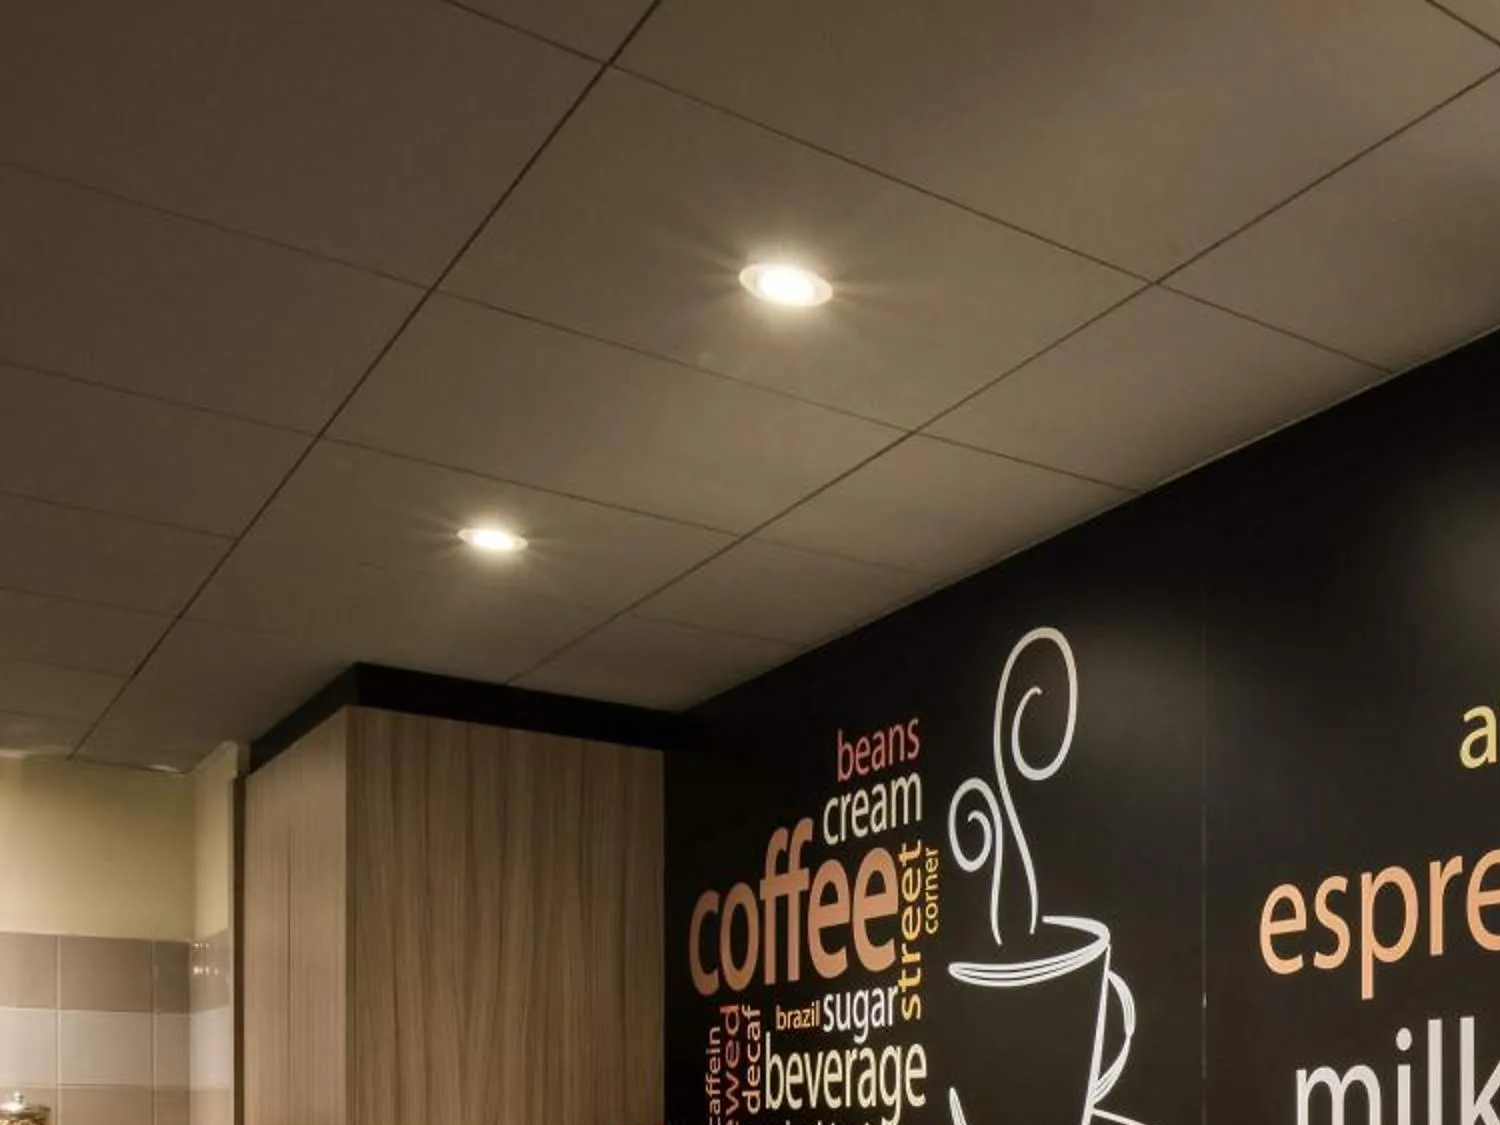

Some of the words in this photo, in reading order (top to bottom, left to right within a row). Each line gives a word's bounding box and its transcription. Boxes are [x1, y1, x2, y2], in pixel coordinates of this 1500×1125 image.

[836, 717, 921, 782] beans
[823, 772, 922, 846] cream
[689, 817, 900, 996] coffee
[898, 840, 922, 1020] street
[924, 848, 939, 934] corner
[775, 1000, 821, 1031] brazil
[823, 985, 899, 1044] sugar
[741, 1004, 761, 1115] decaf
